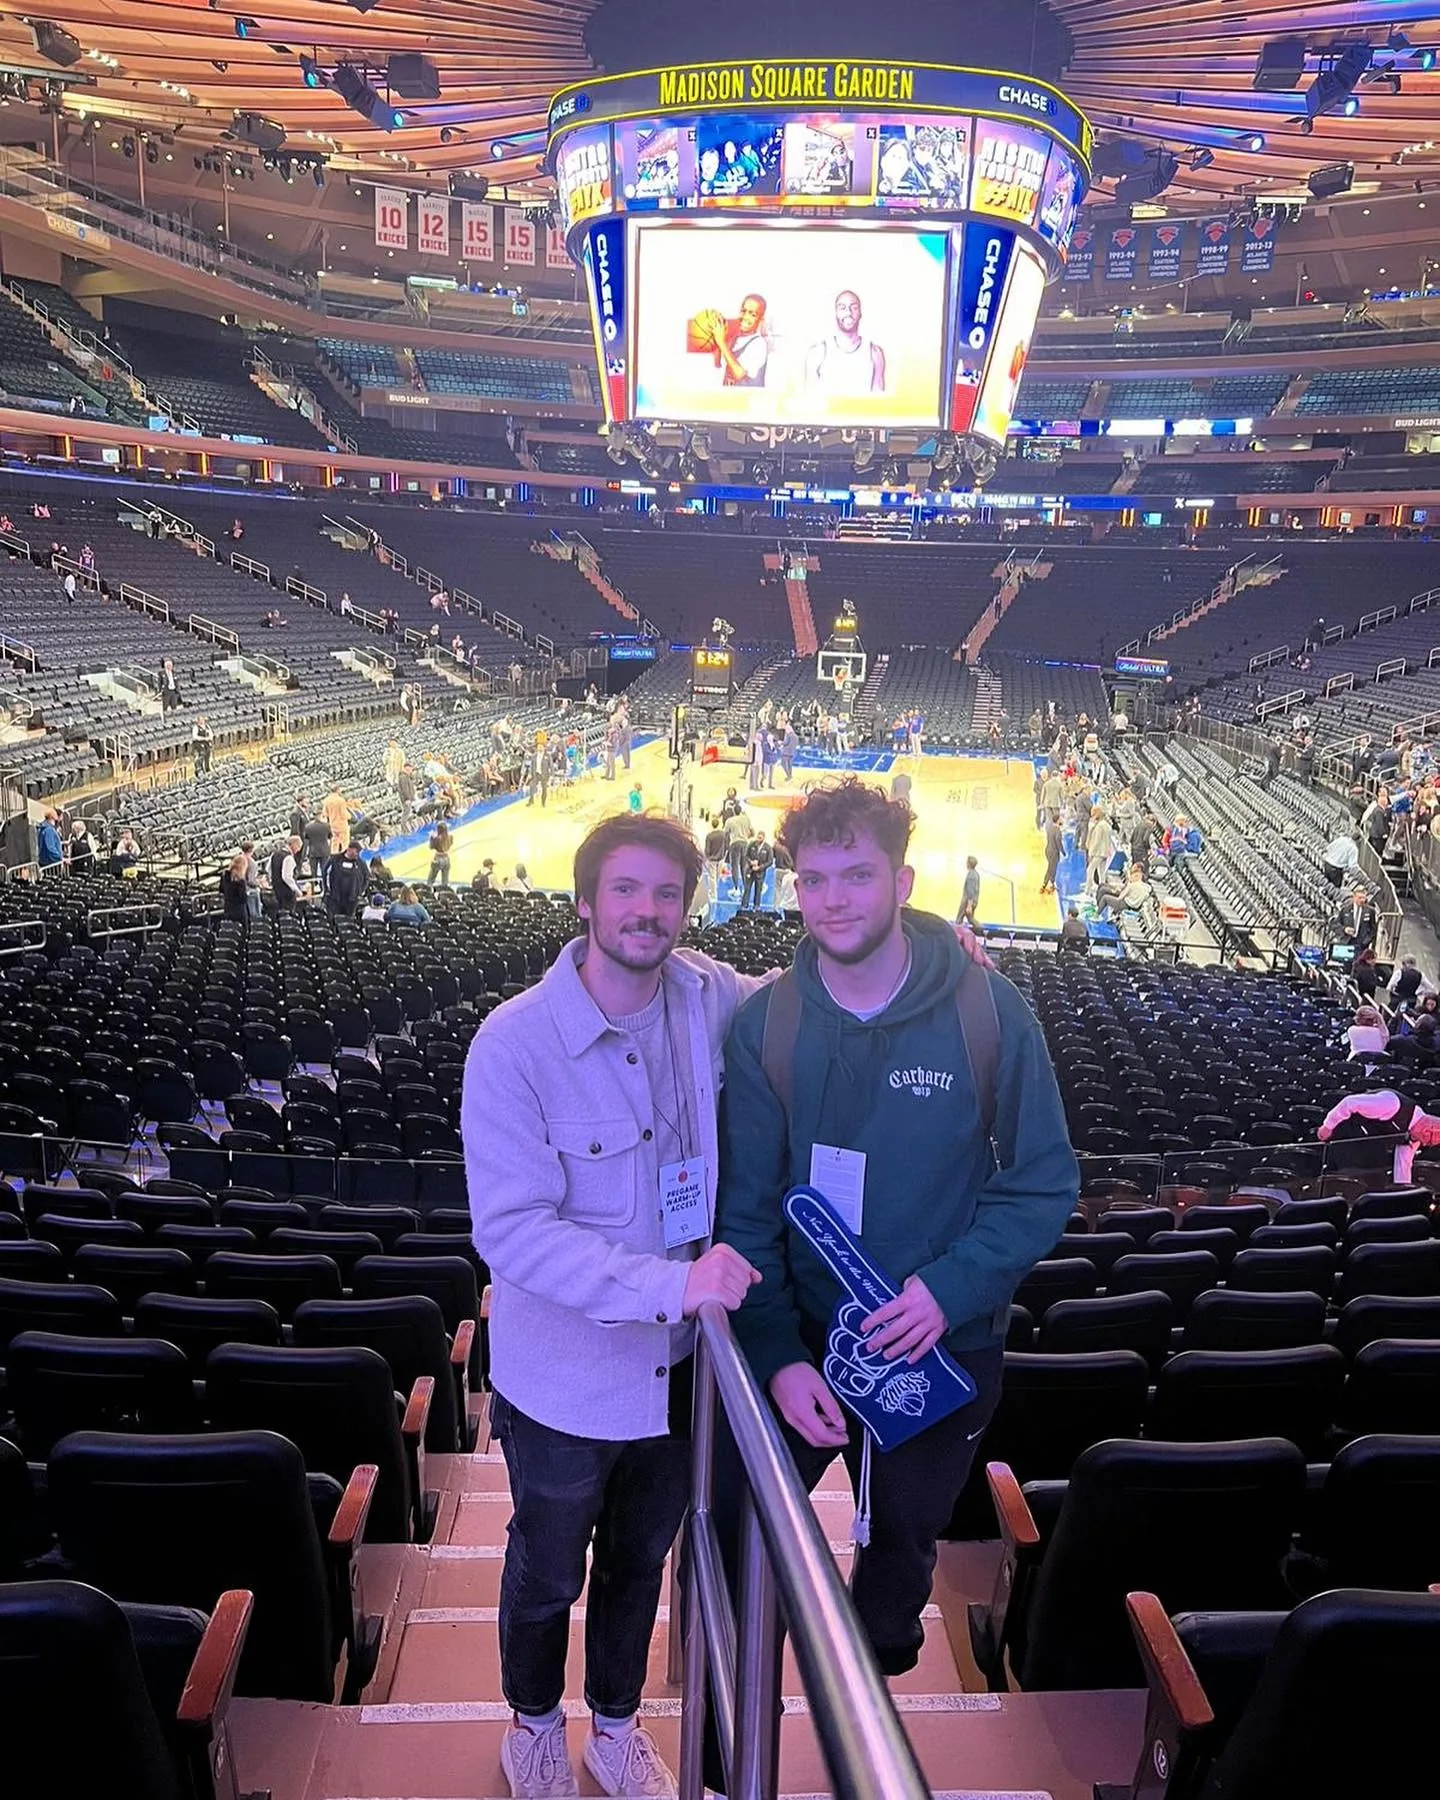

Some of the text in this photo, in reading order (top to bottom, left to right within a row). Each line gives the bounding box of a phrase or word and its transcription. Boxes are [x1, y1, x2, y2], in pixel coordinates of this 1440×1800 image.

[660, 63, 914, 104] MADISON SQUARE GARDEN
[999, 86, 1048, 111] CHASE
[381, 206, 401, 229] 10
[424, 213, 444, 237] 12
[468, 220, 488, 242] 15
[510, 225, 530, 247] 15
[597, 233, 614, 316] CHASE
[974, 239, 1001, 324] CHASE
[389, 394, 430, 404] BUD LIGHT
[1395, 419, 1414, 428] BUD
[889, 1066, 954, 1091] Carhartt
[665, 1190, 701, 1208] WARM-UP
[666, 1183, 699, 1199] PREGAME
[670, 1199, 697, 1213] ACCESS
[862, 1278, 888, 1305] Worl
[880, 1370, 931, 1413] KNICKS
